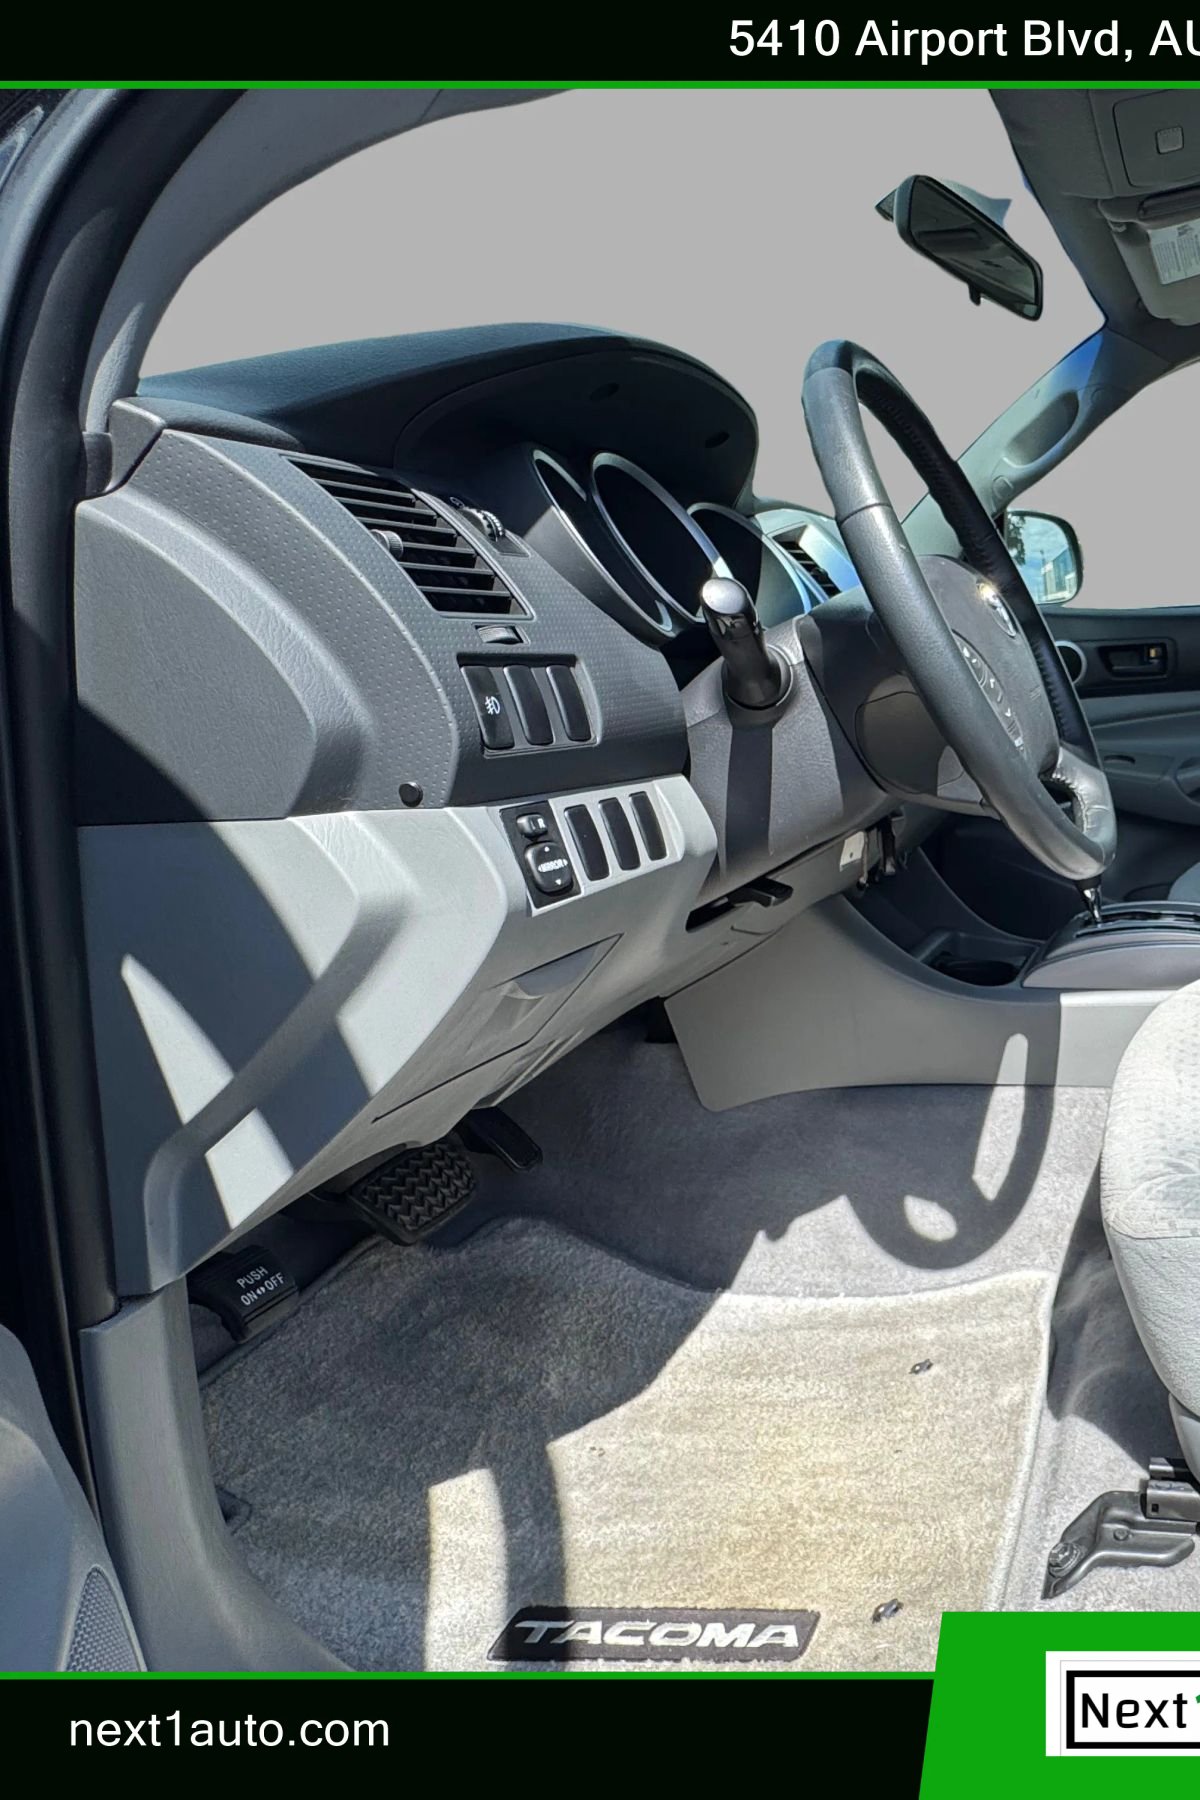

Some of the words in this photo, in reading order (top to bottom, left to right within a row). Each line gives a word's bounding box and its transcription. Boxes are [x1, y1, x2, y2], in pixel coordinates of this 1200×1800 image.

[236, 1265, 268, 1289] PUSH
[240, 1290, 258, 1306] ON
[264, 1272, 284, 1291] OFF
[514, 1619, 799, 1648] TACOMA
